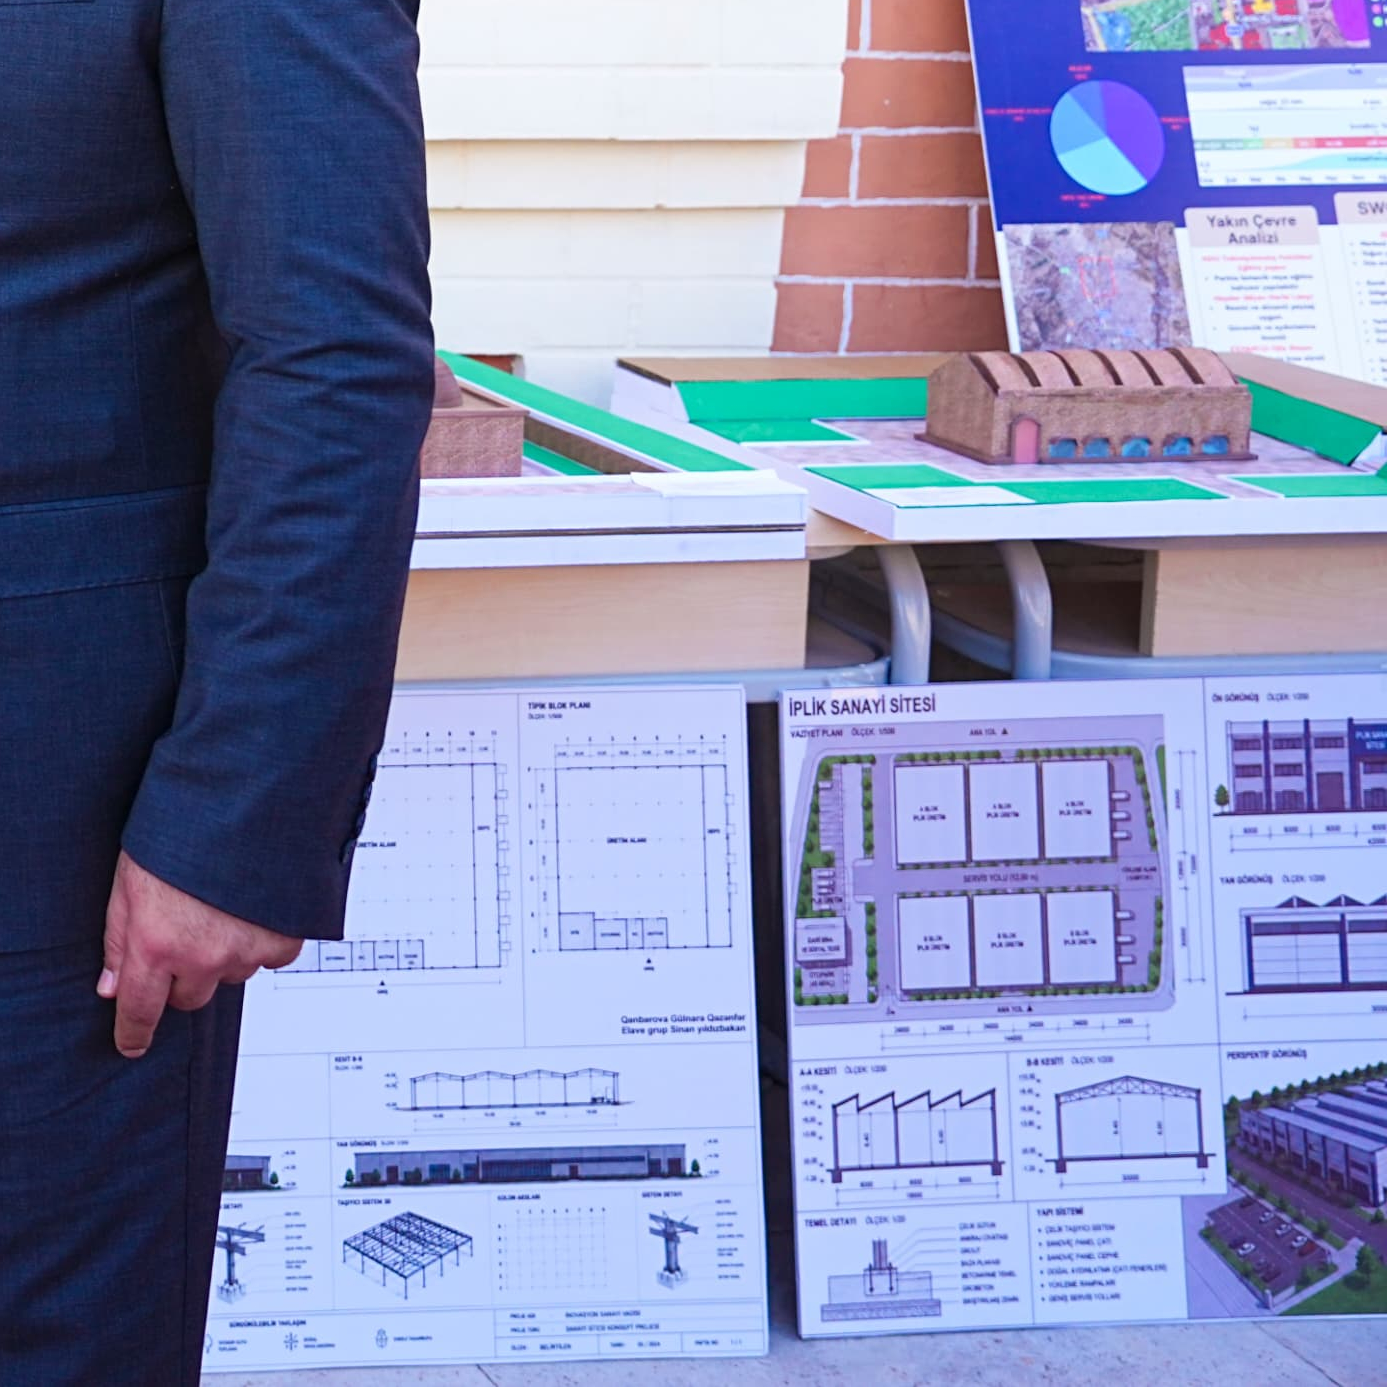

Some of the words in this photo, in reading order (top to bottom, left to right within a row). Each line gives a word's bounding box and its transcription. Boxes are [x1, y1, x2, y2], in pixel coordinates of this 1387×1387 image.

[1207, 216, 1248, 227] Yakın
[1253, 215, 1297, 229] Çevre
[1229, 232, 1278, 244] Analizi
[789, 697, 826, 717] İPLİK
[831, 695, 885, 715] SANAYİ
[890, 693, 936, 713] SİTESİ
[647, 1026, 667, 1036] grup
[670, 1025, 695, 1033] Sinan
